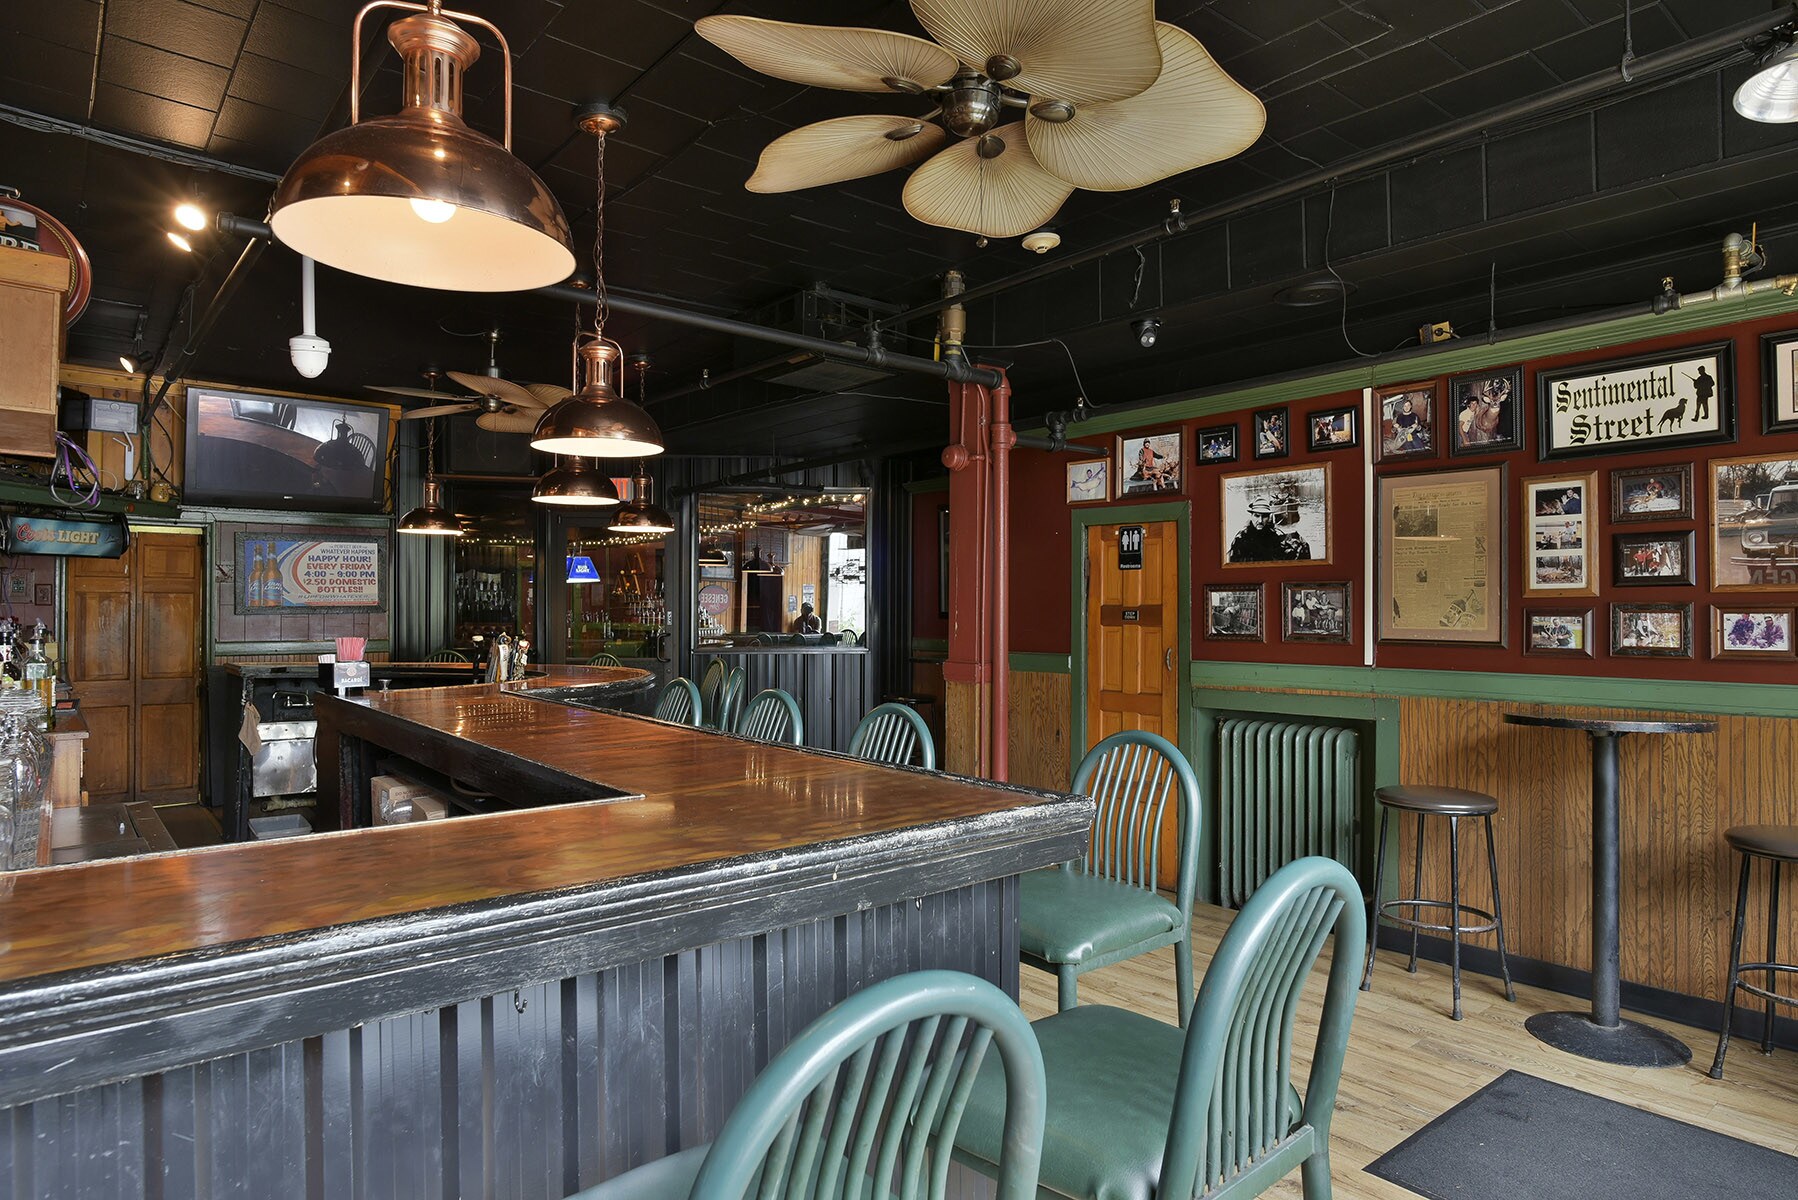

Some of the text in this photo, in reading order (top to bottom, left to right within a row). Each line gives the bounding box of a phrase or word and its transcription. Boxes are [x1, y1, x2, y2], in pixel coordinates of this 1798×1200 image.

[1556, 365, 1675, 413] Sentimental
[1569, 408, 1654, 445] Street
[16, 523, 55, 543] Coors
[58, 530, 99, 544] LIGHT
